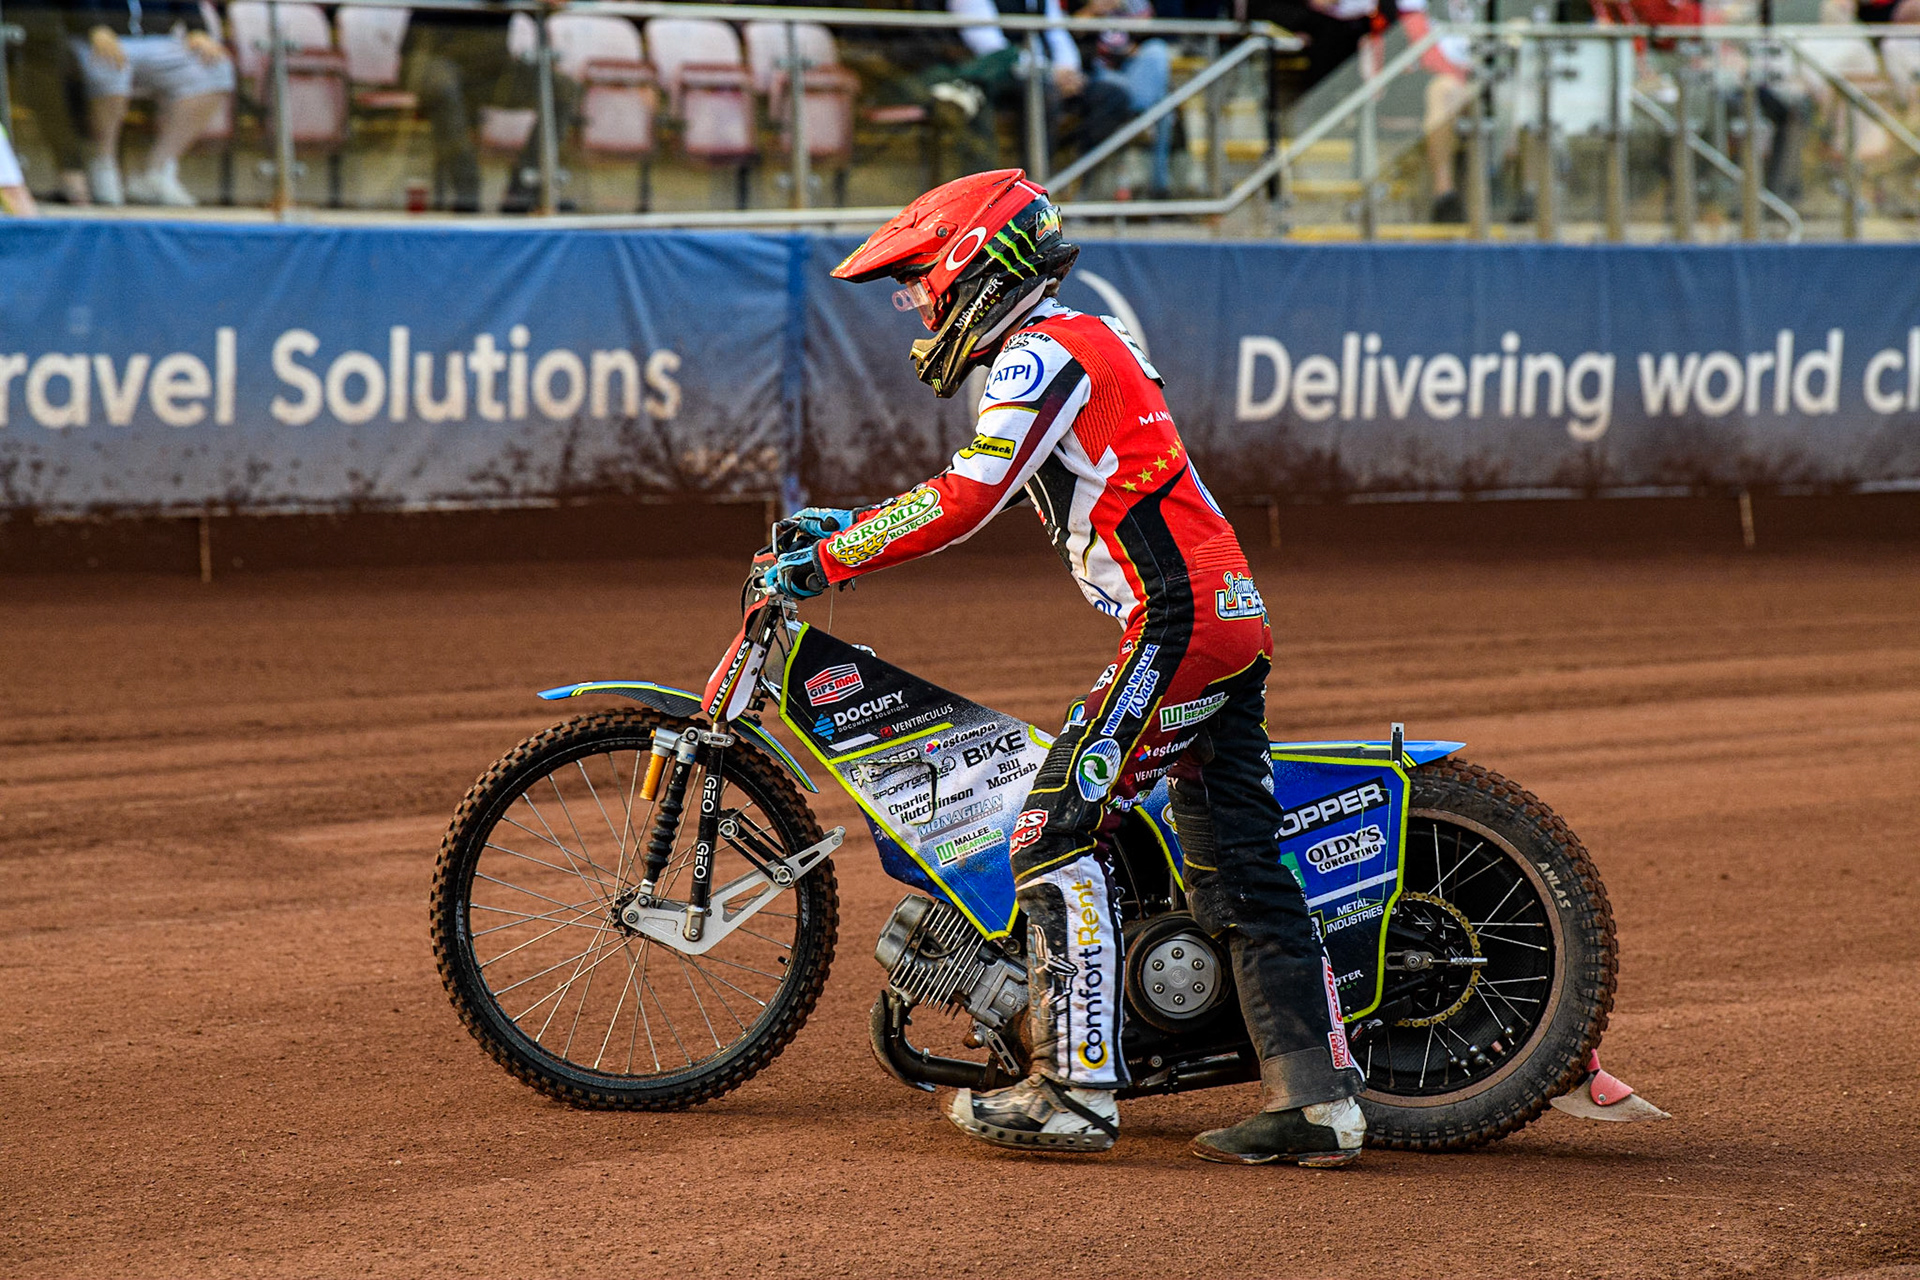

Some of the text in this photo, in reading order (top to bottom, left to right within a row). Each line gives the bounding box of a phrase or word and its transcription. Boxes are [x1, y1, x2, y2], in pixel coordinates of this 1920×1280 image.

[271, 325, 683, 425] Solutions
[992, 364, 1032, 385] ATPI
[1236, 331, 1616, 441] Delivering
[1638, 329, 1844, 416] world
[835, 497, 930, 549] AGROMIX
[833, 690, 904, 727] DOCUFY
[1129, 670, 1159, 718] Waste
[838, 703, 909, 733] DOCUMENT SOLUTIONS
[892, 703, 954, 733] VENTRICULUS
[942, 723, 996, 749] estampa
[962, 730, 1025, 768] BIKE
[986, 763, 1037, 790] Morrish
[997, 758, 1021, 774] Bill
[702, 775, 717, 812] GEO
[888, 792, 930, 815] Charlie
[918, 794, 1004, 836] MONAGHAN
[1275, 783, 1384, 839] OPPER
[954, 826, 990, 846] MALLEE
[957, 829, 1003, 853] BEARINGS
[1308, 826, 1381, 864] OLDY'S
[694, 842, 709, 880] GEO
[1318, 844, 1379, 873] CONCRETING
[1537, 862, 1572, 909] ANLAS
[1326, 906, 1384, 933] INDUSTRIES
[1336, 898, 1370, 917] METAL
[1335, 969, 1364, 987] STER
